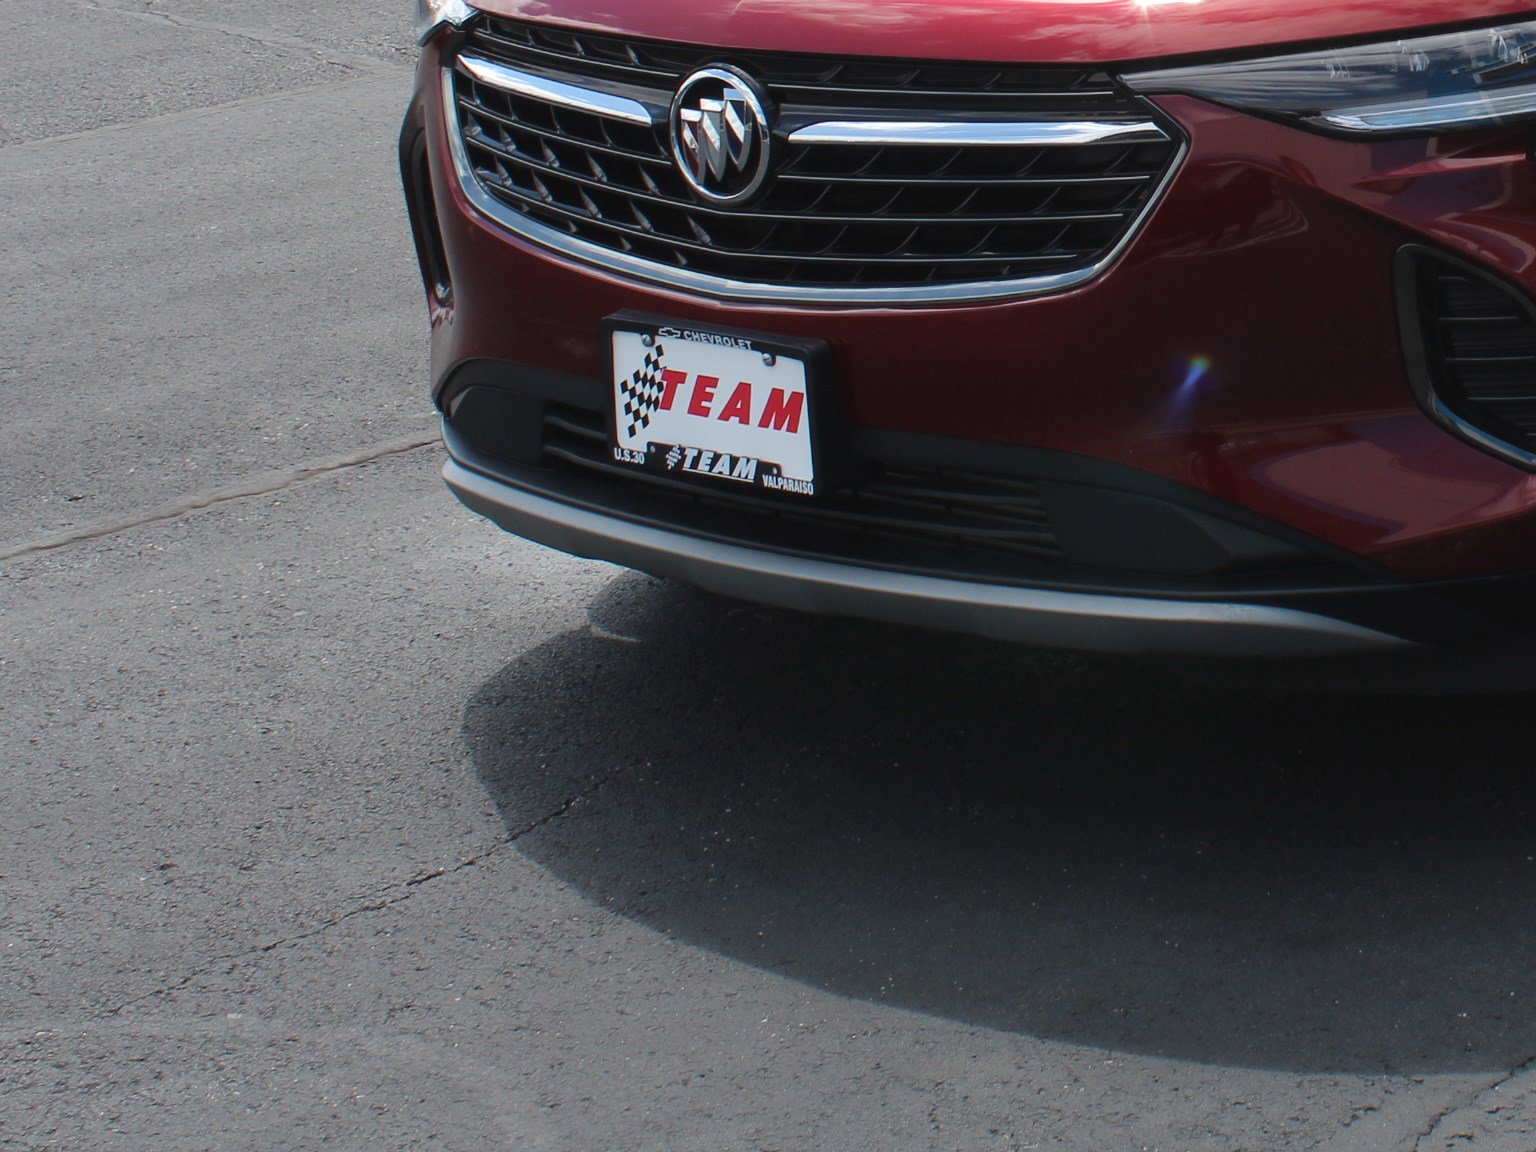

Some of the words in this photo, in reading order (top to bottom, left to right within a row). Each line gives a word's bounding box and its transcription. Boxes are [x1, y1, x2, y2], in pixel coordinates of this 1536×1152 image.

[684, 330, 752, 349] CHEVROLET
[659, 369, 804, 433] TEAM
[682, 447, 759, 480] TEAM
[762, 474, 814, 495] VALPARAISO
